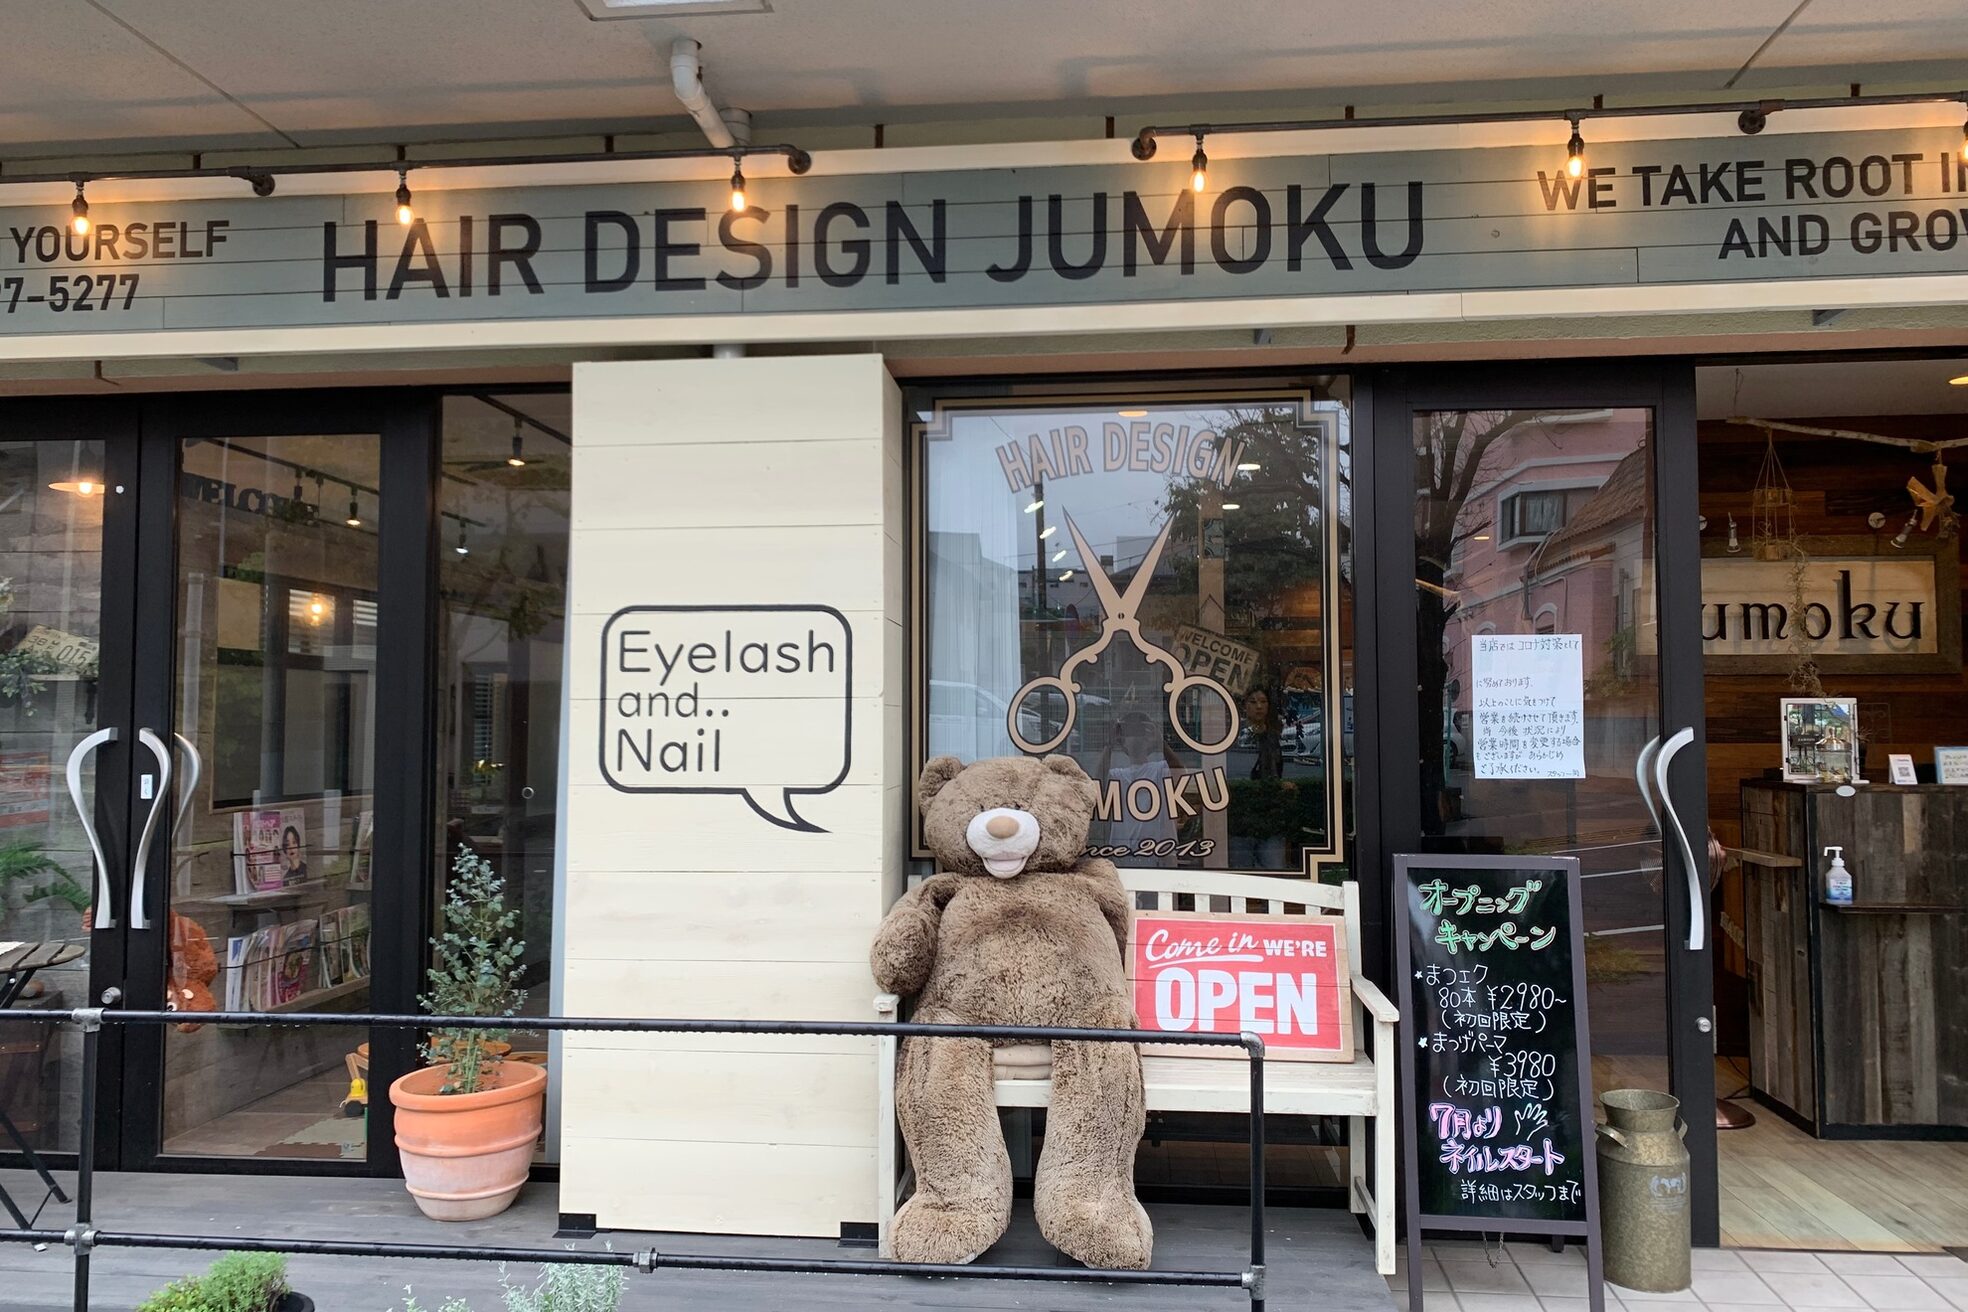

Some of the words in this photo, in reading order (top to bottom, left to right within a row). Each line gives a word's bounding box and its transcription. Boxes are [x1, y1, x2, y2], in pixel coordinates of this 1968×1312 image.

[1536, 167, 1616, 211] WE
[1632, 161, 1765, 206] TAKE
[1786, 153, 1923, 199] ROOT
[10, 220, 229, 263] YOURSELF
[323, 213, 544, 302] HAIR
[585, 199, 946, 293] DESIGN
[985, 181, 1424, 282] JUMOKU
[1718, 214, 1830, 259] AND
[0, 274, 139, 313] 7-5277
[995, 425, 1094, 494] HAIR
[1102, 421, 1246, 487] DESIGN
[619, 629, 834, 686] Eyelash
[1172, 642, 1250, 690] OPEN
[1175, 630, 1255, 665] WELCOME
[618, 682, 730, 718] and..
[617, 728, 721, 772] Nail
[1134, 838, 1216, 858] 2013
[1418, 878, 1543, 915] オープニング
[1146, 929, 1221, 961] Come
[1227, 932, 1259, 953] in
[1263, 939, 1327, 957] WE'RE
[1435, 919, 1556, 955] キャンペーン
[1156, 967, 1317, 1035] OPEN
[1439, 986, 1476, 1009] 80本
[1432, 1031, 1508, 1054] まつげパーマ
[1488, 1050, 1556, 1078] ¥3980
[1429, 1103, 1502, 1139] 7月より
[1440, 1138, 1565, 1175] ネイルスタート
[1461, 1179, 1581, 1204] 詳細はスタッフまで
